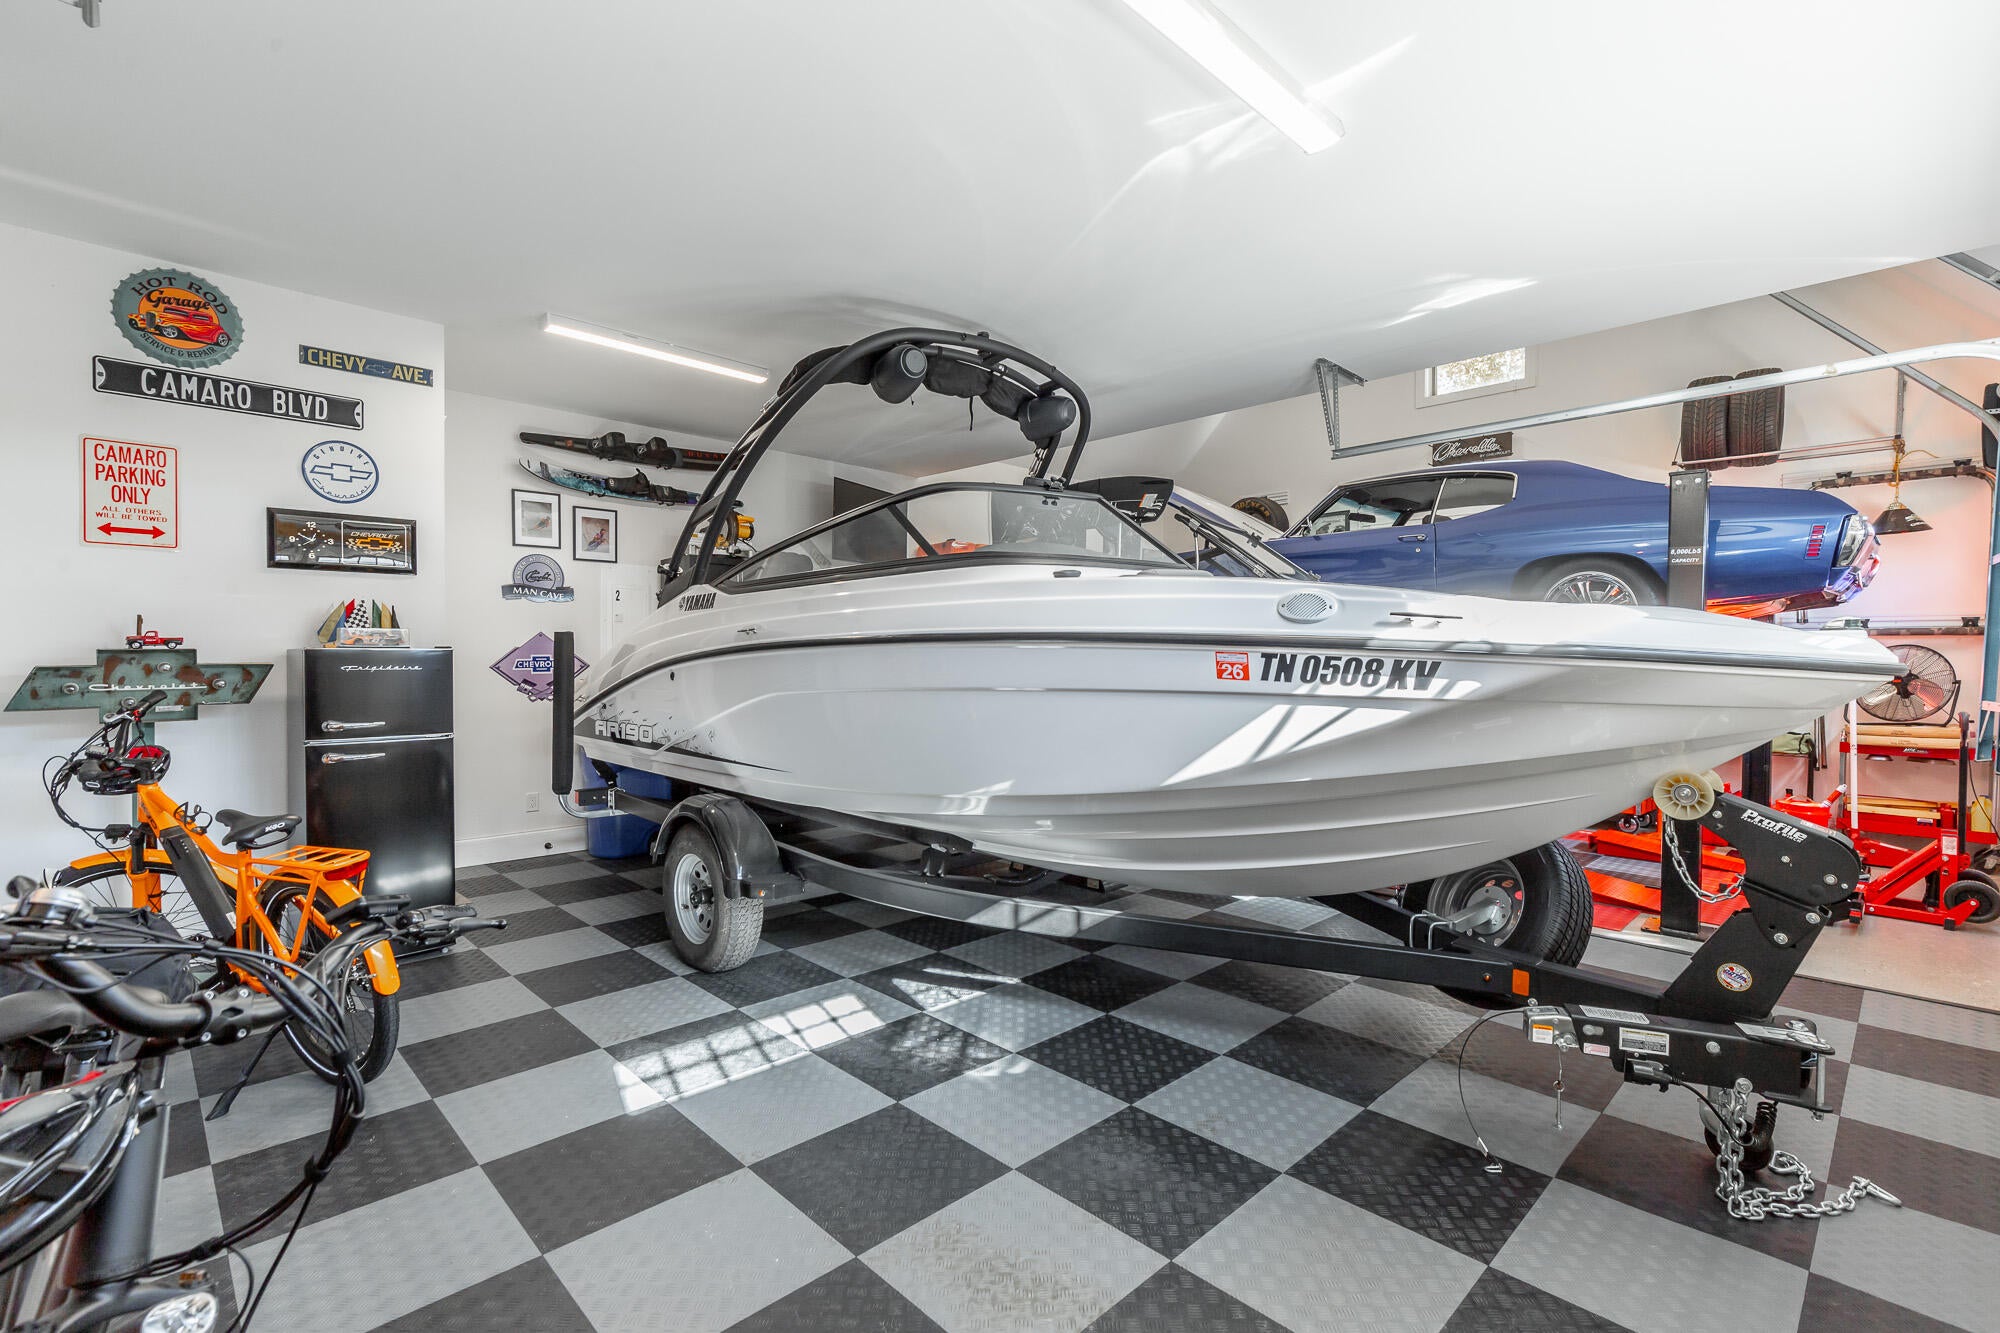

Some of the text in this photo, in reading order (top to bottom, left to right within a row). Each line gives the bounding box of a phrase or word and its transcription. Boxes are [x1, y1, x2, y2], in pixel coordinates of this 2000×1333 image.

[131, 276, 228, 315] HOT ROD
[146, 289, 211, 311] Garage
[140, 331, 177, 356] SERVICE
[186, 345, 217, 359] REPAIR
[307, 348, 367, 373] CHEVY
[140, 368, 329, 421] CAMARO BLVD
[94, 443, 167, 468] CAMARO
[95, 463, 166, 487] PARKING
[111, 484, 151, 505] ONLY
[312, 477, 372, 499] Chevrolet
[95, 511, 117, 519] WILL
[138, 514, 168, 523] TOWED
[125, 507, 162, 516] OTHERS
[306, 521, 317, 529] 12
[350, 531, 400, 540] CHEVROLET
[512, 587, 565, 600] MAN CAVE
[615, 590, 621, 601] 2
[684, 592, 717, 612] YAMAHA
[340, 664, 422, 672] Frigidaire
[516, 660, 554, 669] CHEVRO
[1222, 663, 1244, 680] 26
[1260, 652, 1442, 691] TN 0508 KV
[88, 682, 208, 692] Chevrolet
[594, 720, 653, 743] AR190
[1742, 808, 1808, 840] Profile
